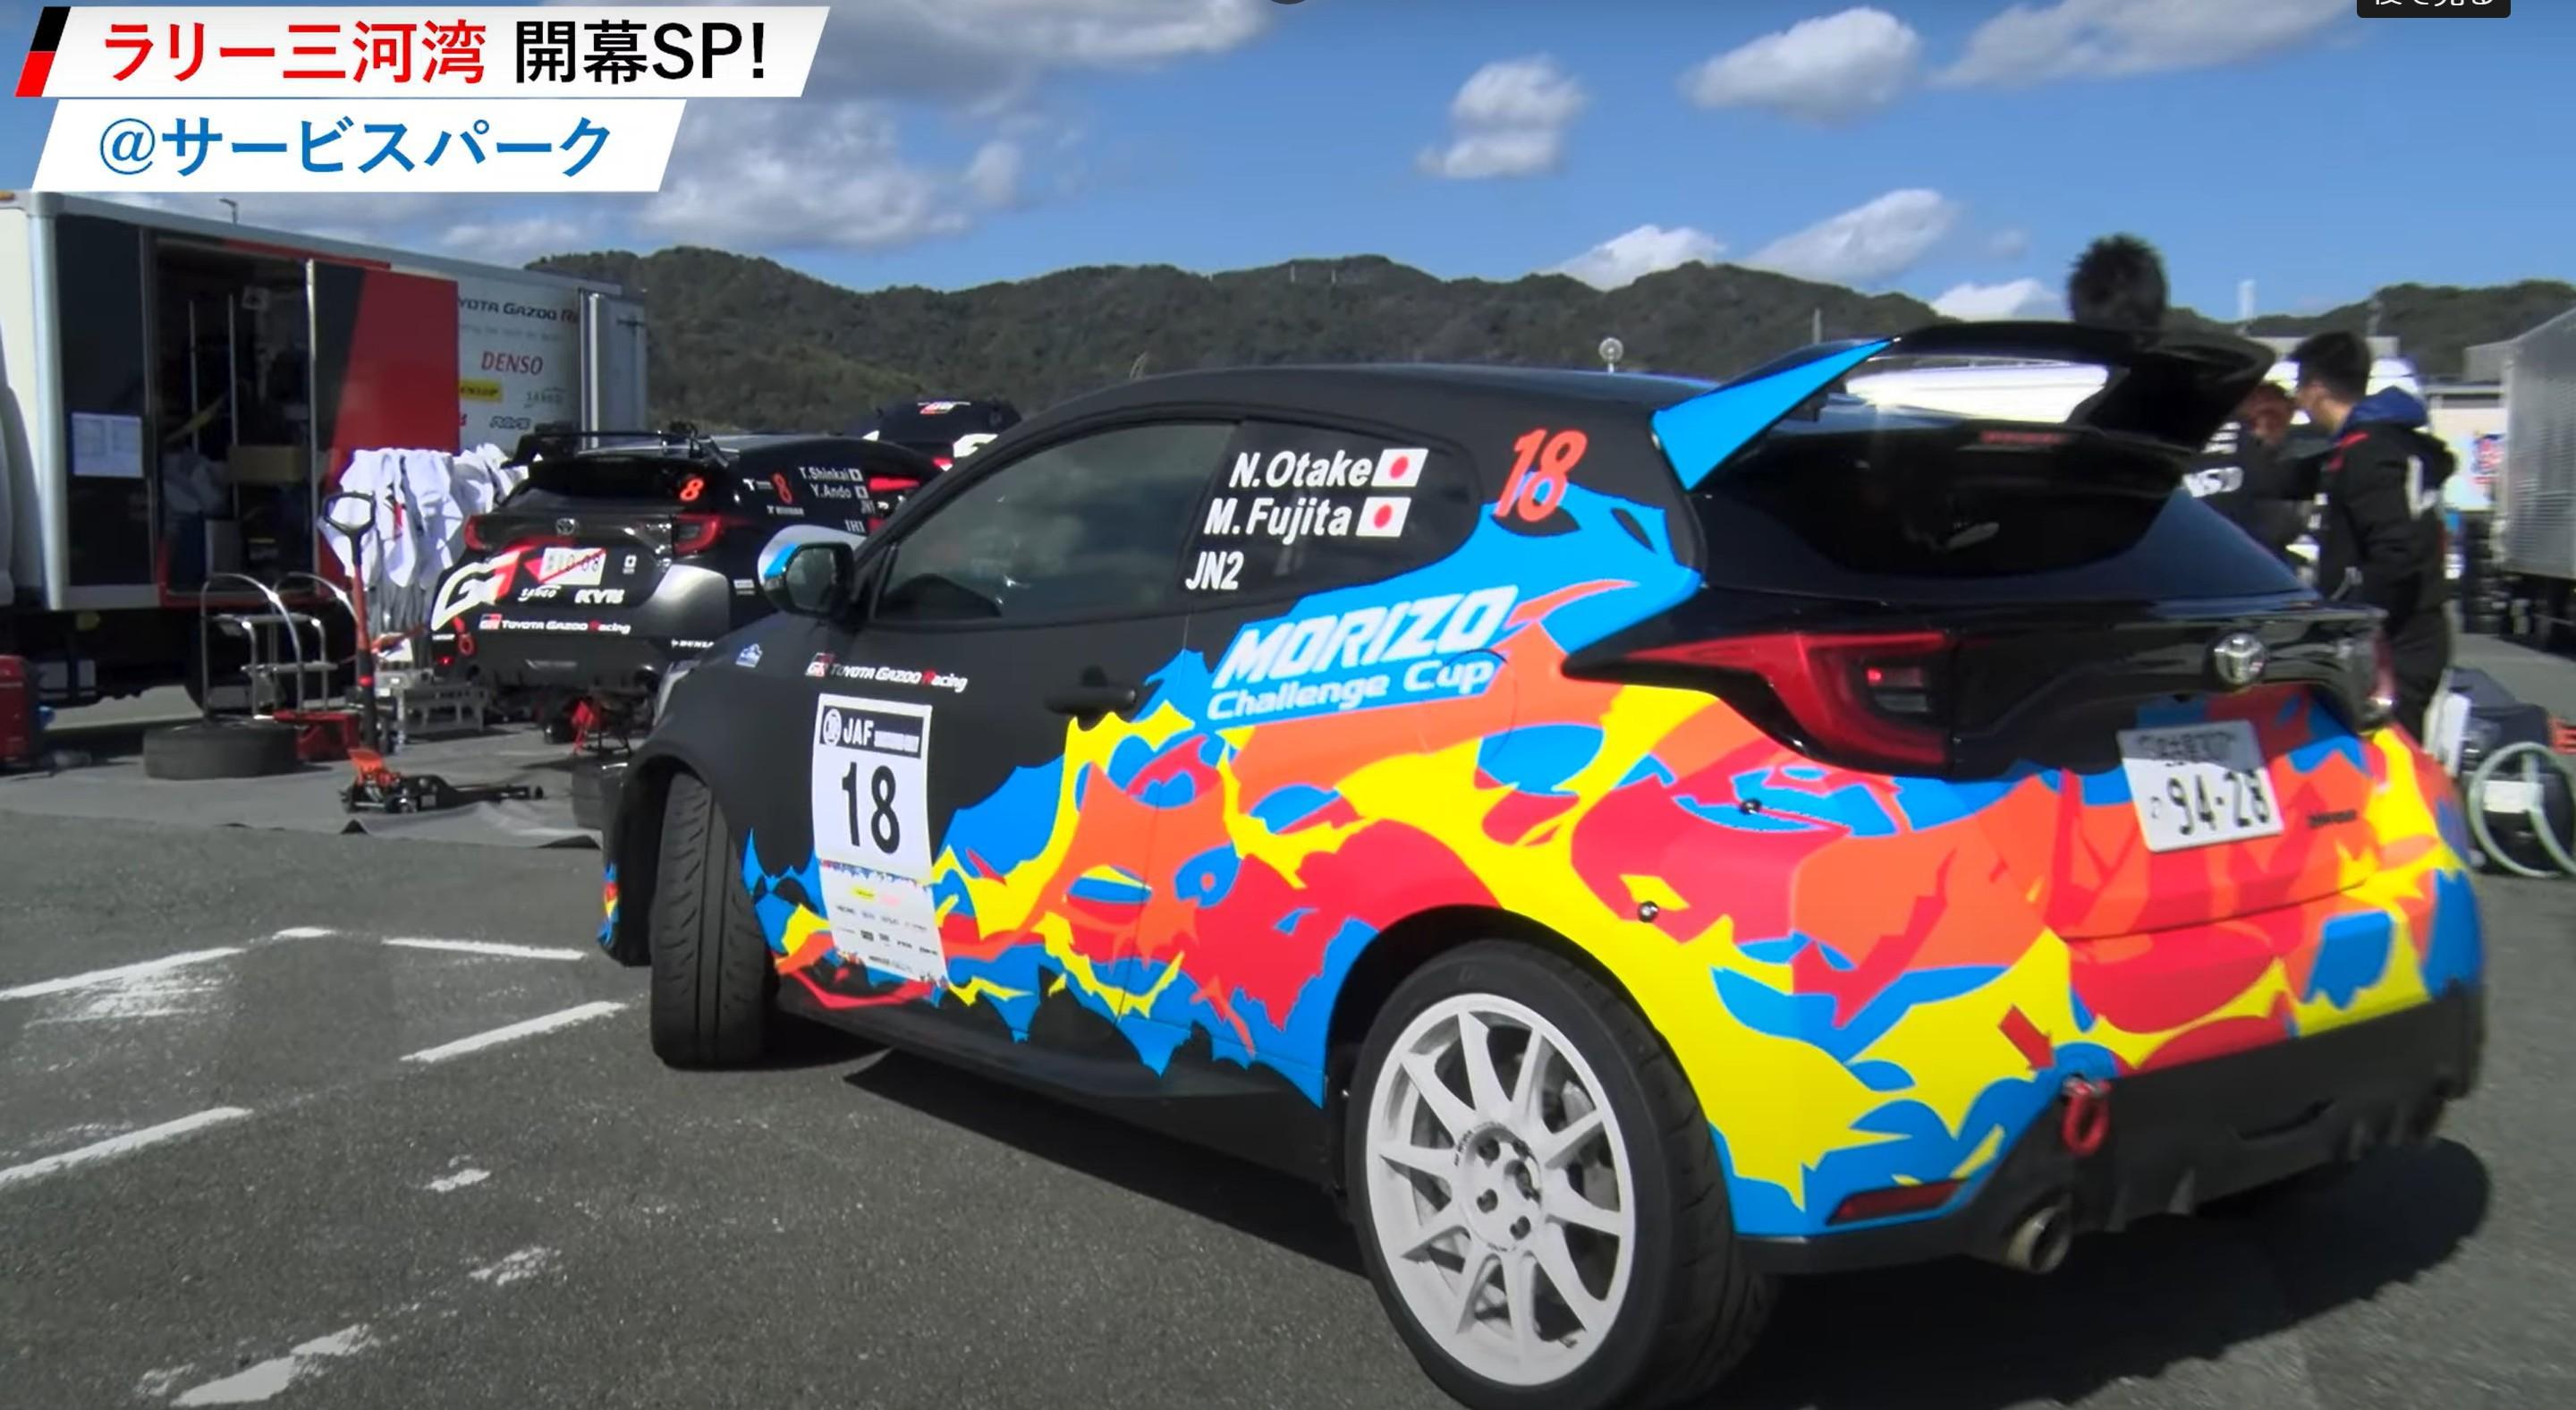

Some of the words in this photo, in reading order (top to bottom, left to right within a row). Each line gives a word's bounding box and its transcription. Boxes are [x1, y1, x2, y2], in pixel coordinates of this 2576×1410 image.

[481, 351, 543, 375] DENSO
[1229, 449, 1373, 488] N.Otake
[1495, 428, 1588, 522] 18
[680, 478, 704, 501] 8
[773, 472, 792, 505] 8
[1204, 497, 1352, 546] M.Fujita
[1185, 551, 1245, 590] JN2
[574, 589, 625, 604] KYB
[502, 620, 545, 631] TOYOTA
[546, 620, 588, 632] GAZOO
[588, 620, 631, 634] Racing
[1211, 584, 1519, 689] MORIZO
[830, 663, 874, 679] TOYOTA
[875, 666, 921, 684] GAZOO
[921, 667, 969, 693] Racing
[1207, 675, 1391, 719] Challenge
[1403, 659, 1495, 694] Cup
[843, 718, 875, 746] JAF
[842, 761, 901, 854] 18
